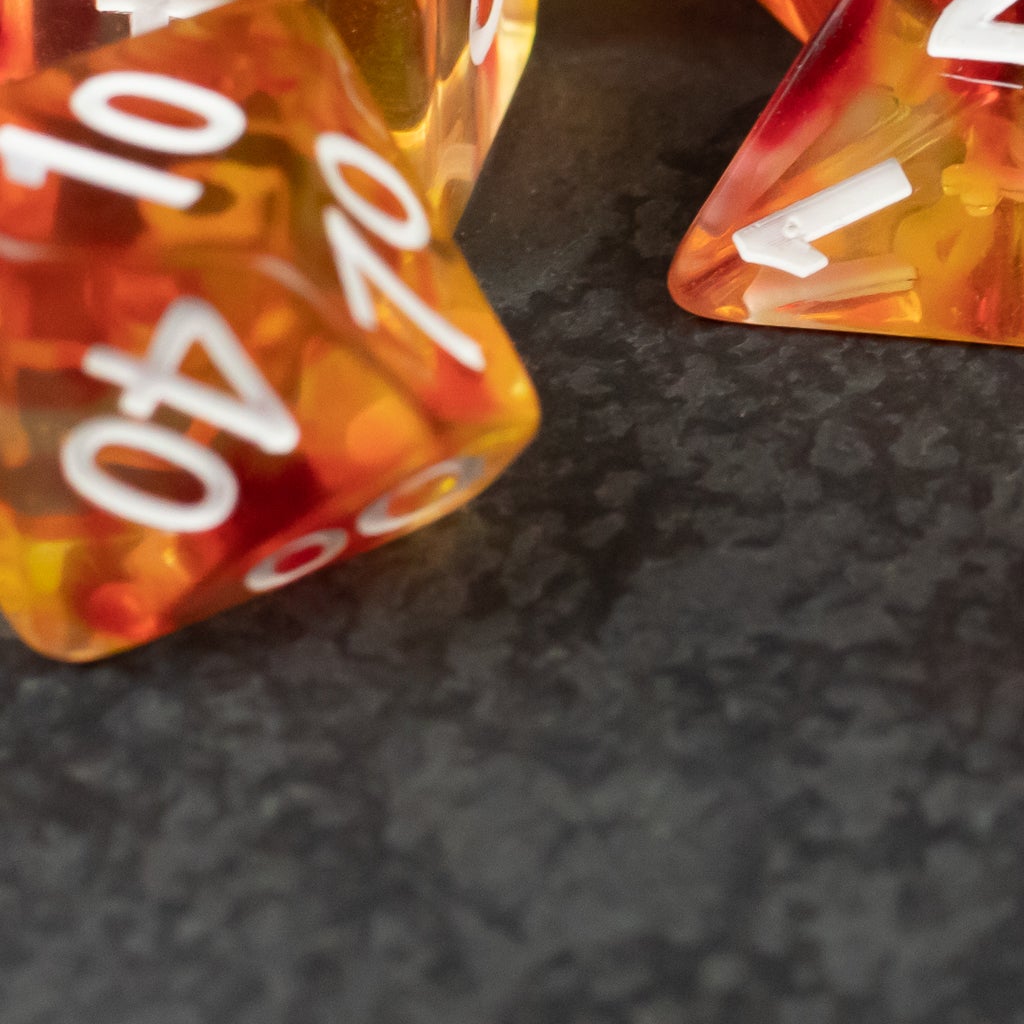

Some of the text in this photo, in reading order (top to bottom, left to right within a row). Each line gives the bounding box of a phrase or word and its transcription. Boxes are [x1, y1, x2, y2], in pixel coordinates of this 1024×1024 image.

[0, 70, 247, 210] 10
[732, 158, 912, 278] 1
[60, 296, 301, 534] 40
